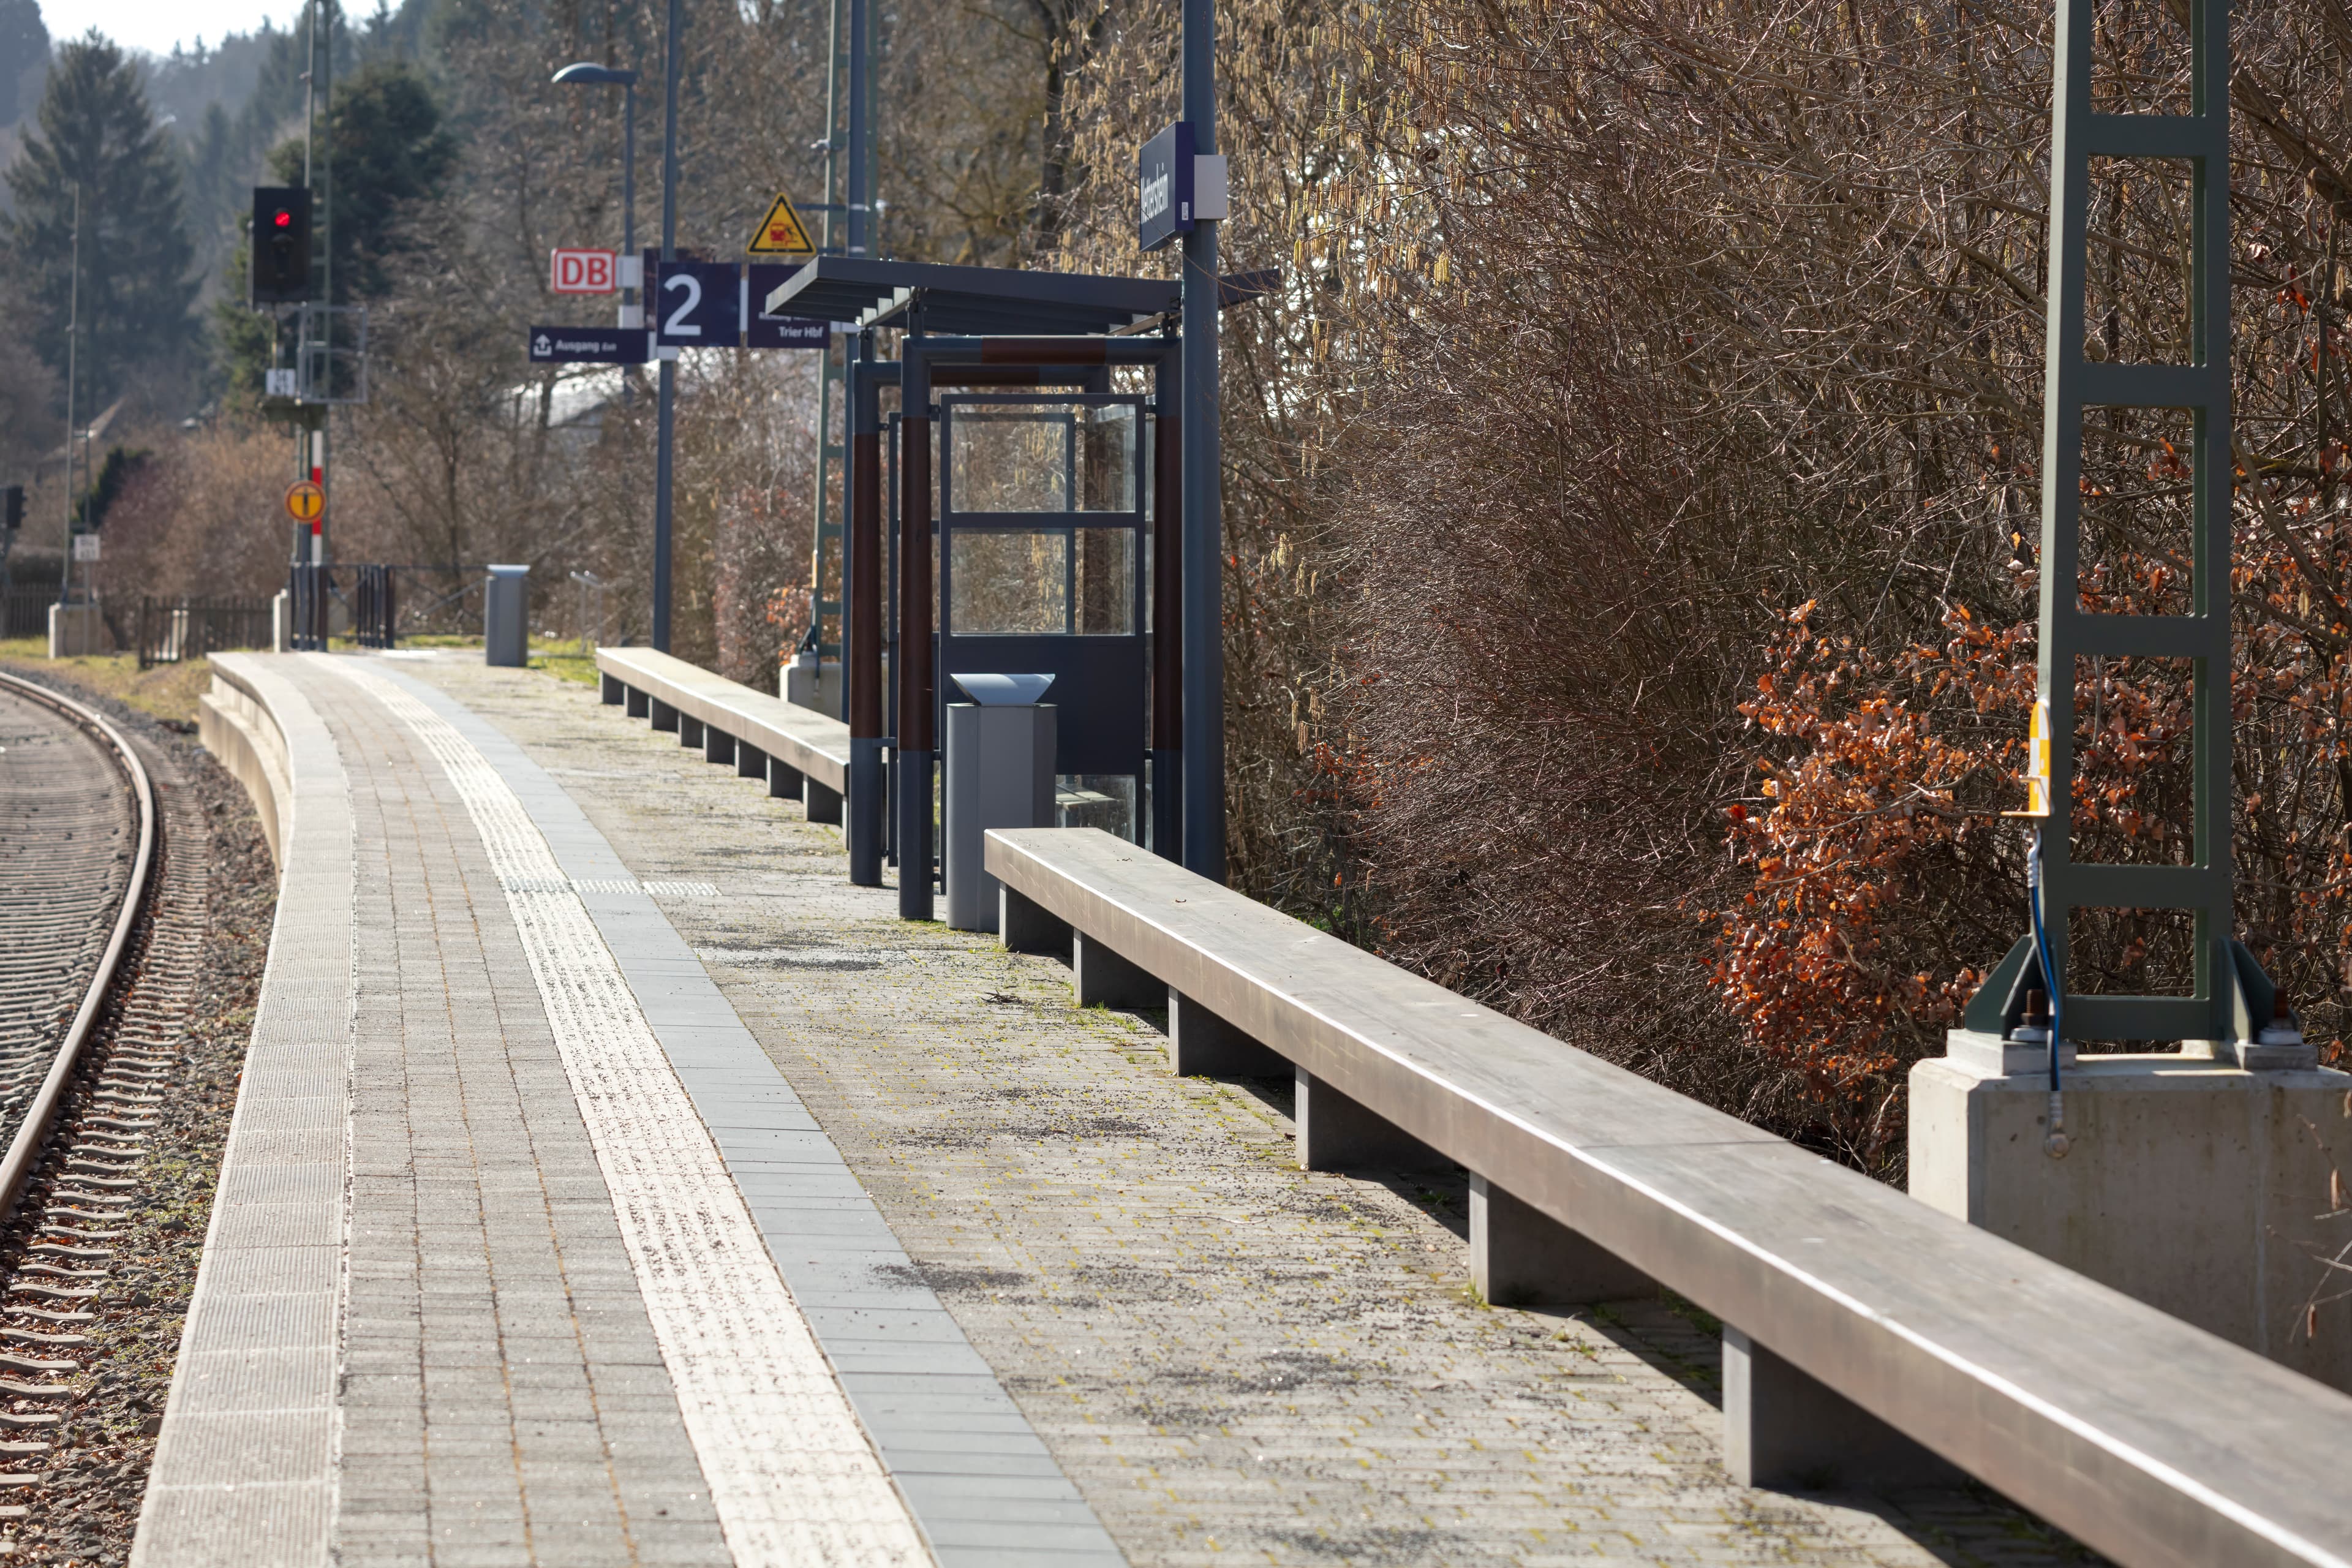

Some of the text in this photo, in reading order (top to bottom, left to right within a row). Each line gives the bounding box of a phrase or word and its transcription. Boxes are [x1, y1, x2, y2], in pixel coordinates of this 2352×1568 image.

[562, 257, 608, 285] DB
[663, 273, 702, 336] 2
[778, 326, 823, 338] Trier Hbf
[555, 339, 600, 353] Ausgang
